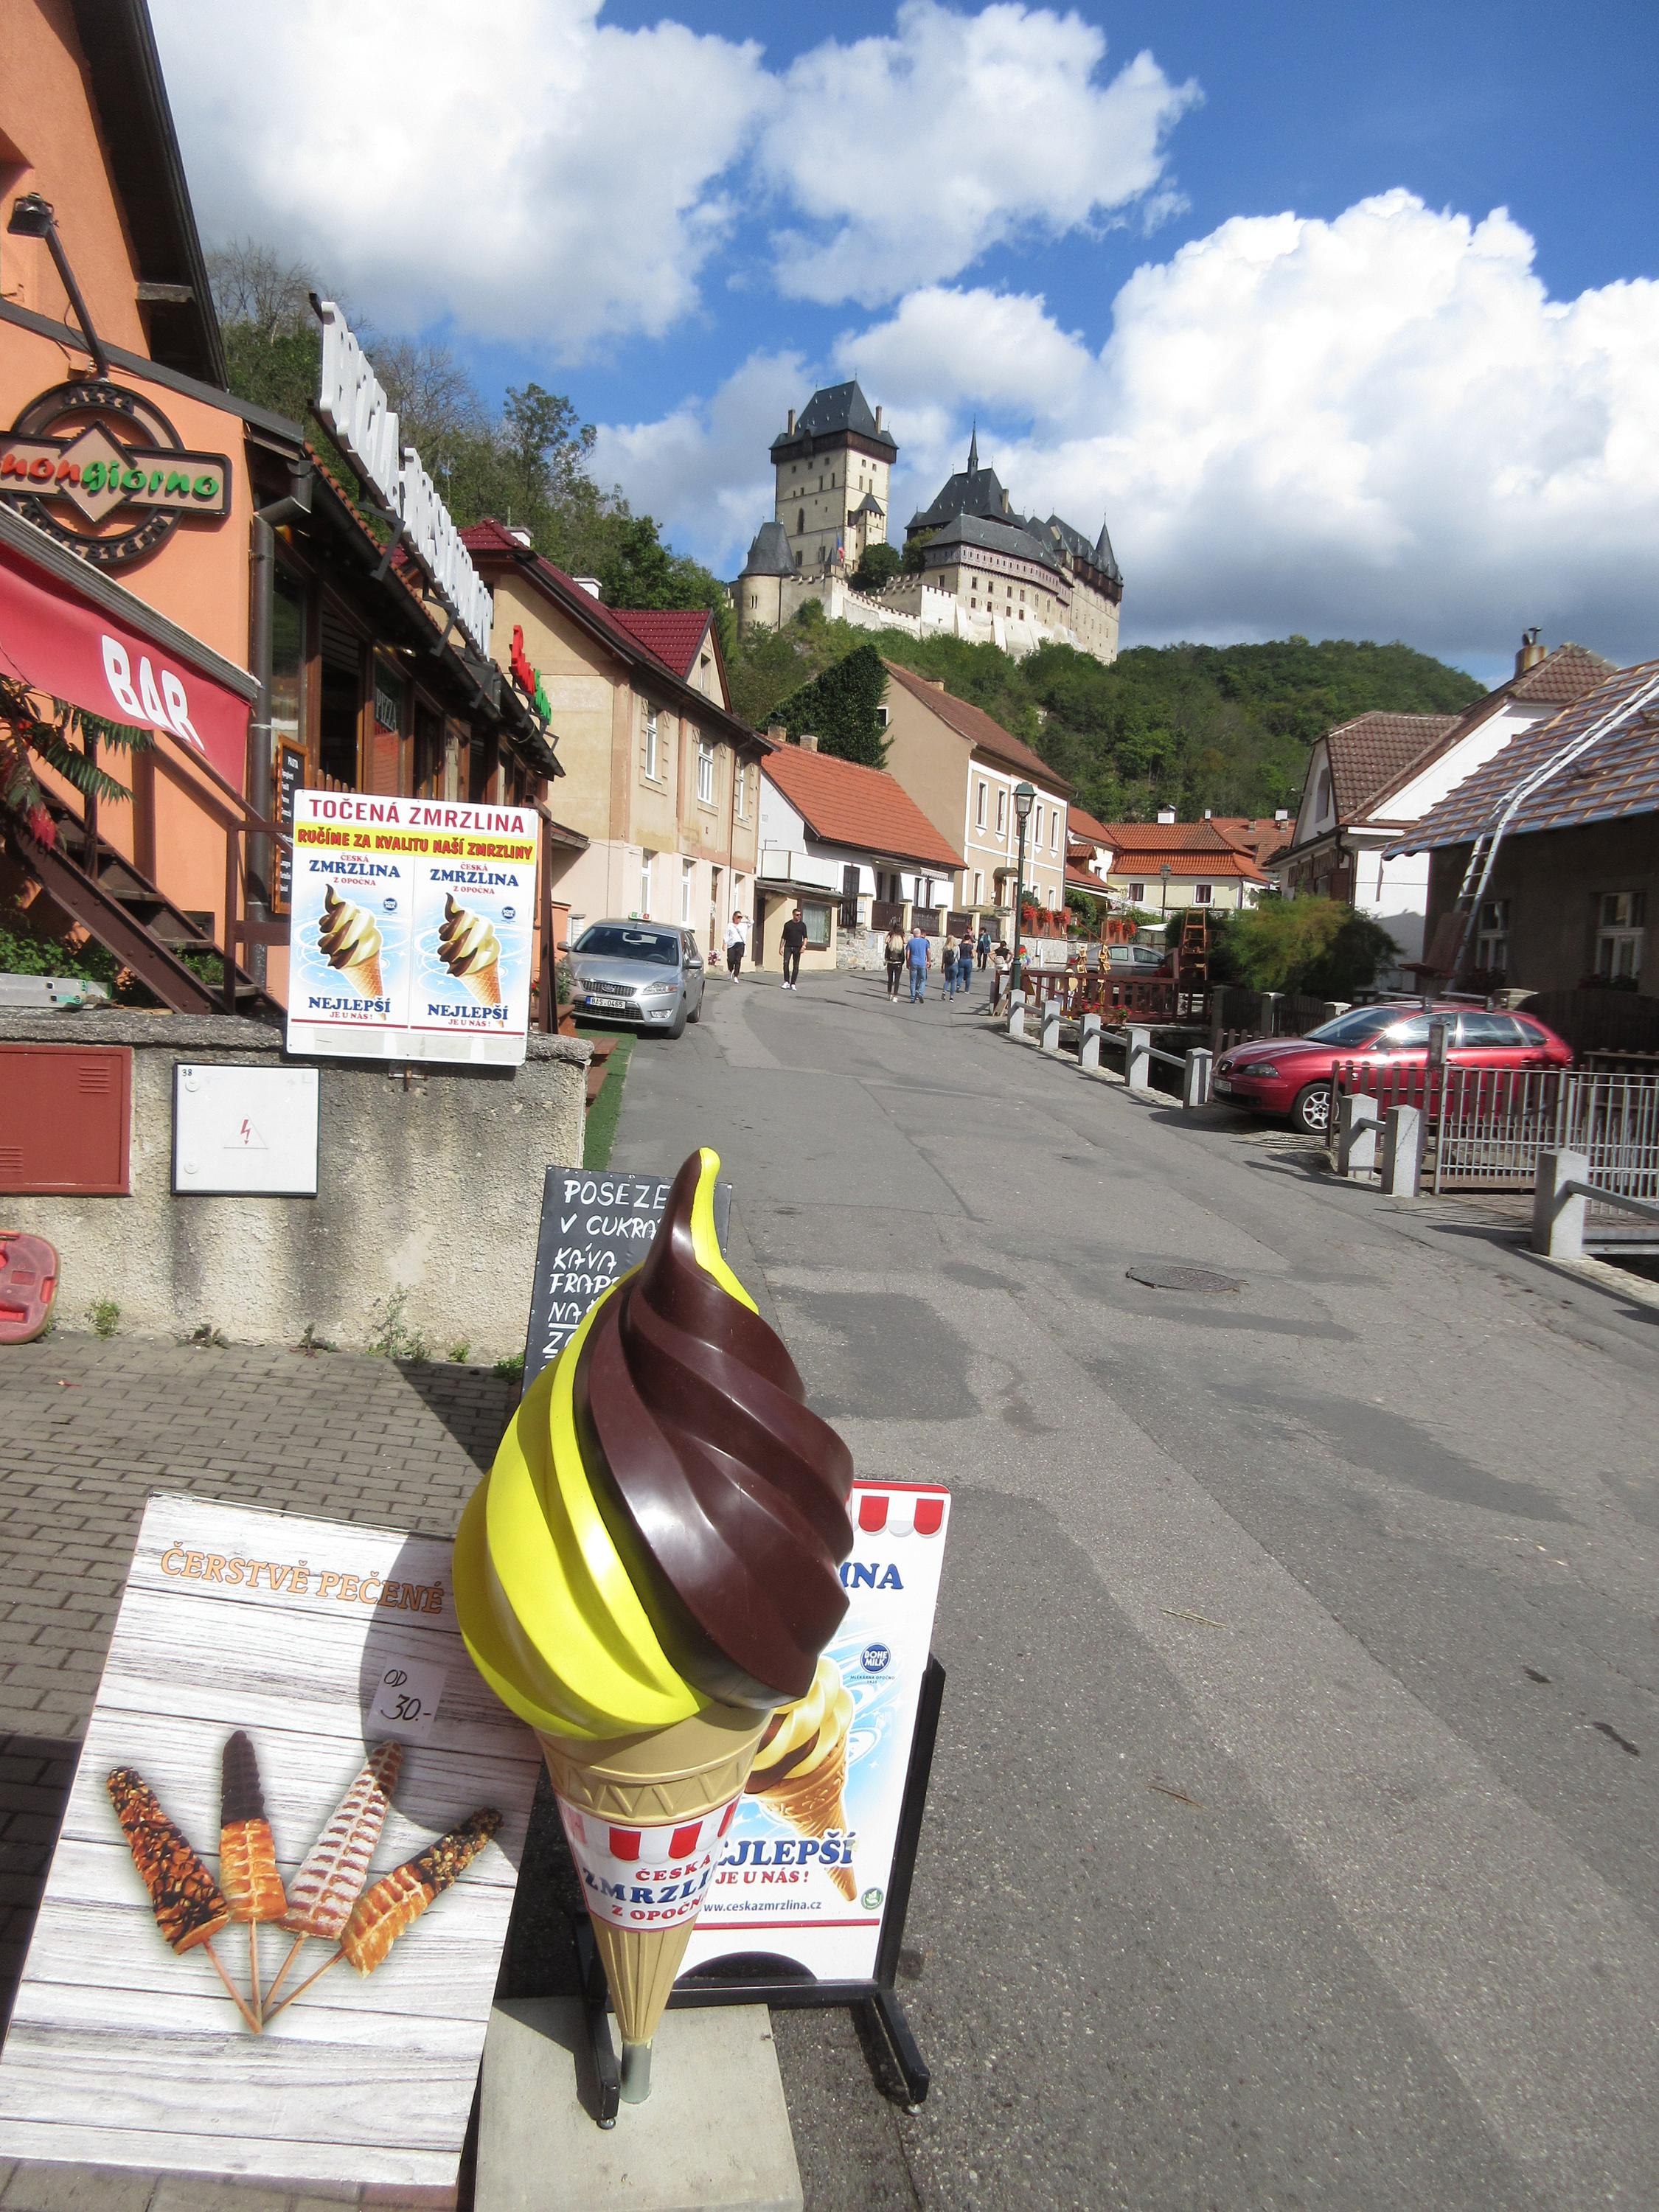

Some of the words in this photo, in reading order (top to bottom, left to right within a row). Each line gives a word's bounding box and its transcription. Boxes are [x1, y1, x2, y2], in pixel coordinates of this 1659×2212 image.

[101, 634, 205, 751] BAR
[309, 798, 400, 823] TOČENÁ
[408, 806, 524, 833] ZMRZLINA
[297, 826, 349, 846] RUČÍME
[354, 834, 370, 848] ZA
[375, 835, 428, 852] KVALITU
[433, 837, 465, 855] NAŠÍ
[467, 842, 533, 860] ZMRZLINY
[340, 852, 369, 863] ČESKÁ
[460, 861, 488, 872] ČESKÁ
[309, 859, 401, 878] ZMRZLINA
[430, 869, 519, 886] ZMRZLINA
[342, 877, 376, 886] OPOČNA
[461, 886, 495, 895] OPOČNA
[308, 996, 391, 1013] NEJLEPŠÍ
[428, 1004, 509, 1020] NEJLEPŠÍ
[182, 1068, 192, 1077] 38
[560, 1214, 578, 1234] V
[553, 1242, 618, 1275] KÁVA
[549, 1273, 621, 1295] FRAP
[548, 1301, 582, 1324] NA
[543, 1331, 575, 1354] Z
[161, 1541, 310, 1595] ČERSTVĚ
[316, 1571, 445, 1615] PEČENÉ
[864, 1650, 888, 1659] BOHE
[864, 1658, 886, 1666] MILK
[383, 1669, 407, 1687] OD
[635, 1852, 712, 1881] ČESKÁ
[582, 1864, 715, 1905] ZMRZLI
[715, 1871, 739, 1885] JE
[744, 1871, 757, 1884] U
[612, 1905, 623, 1916] Z
[630, 1896, 706, 1921] OPOČN
[700, 1899, 822, 1913] ww.ceskazmrzlina.cz
